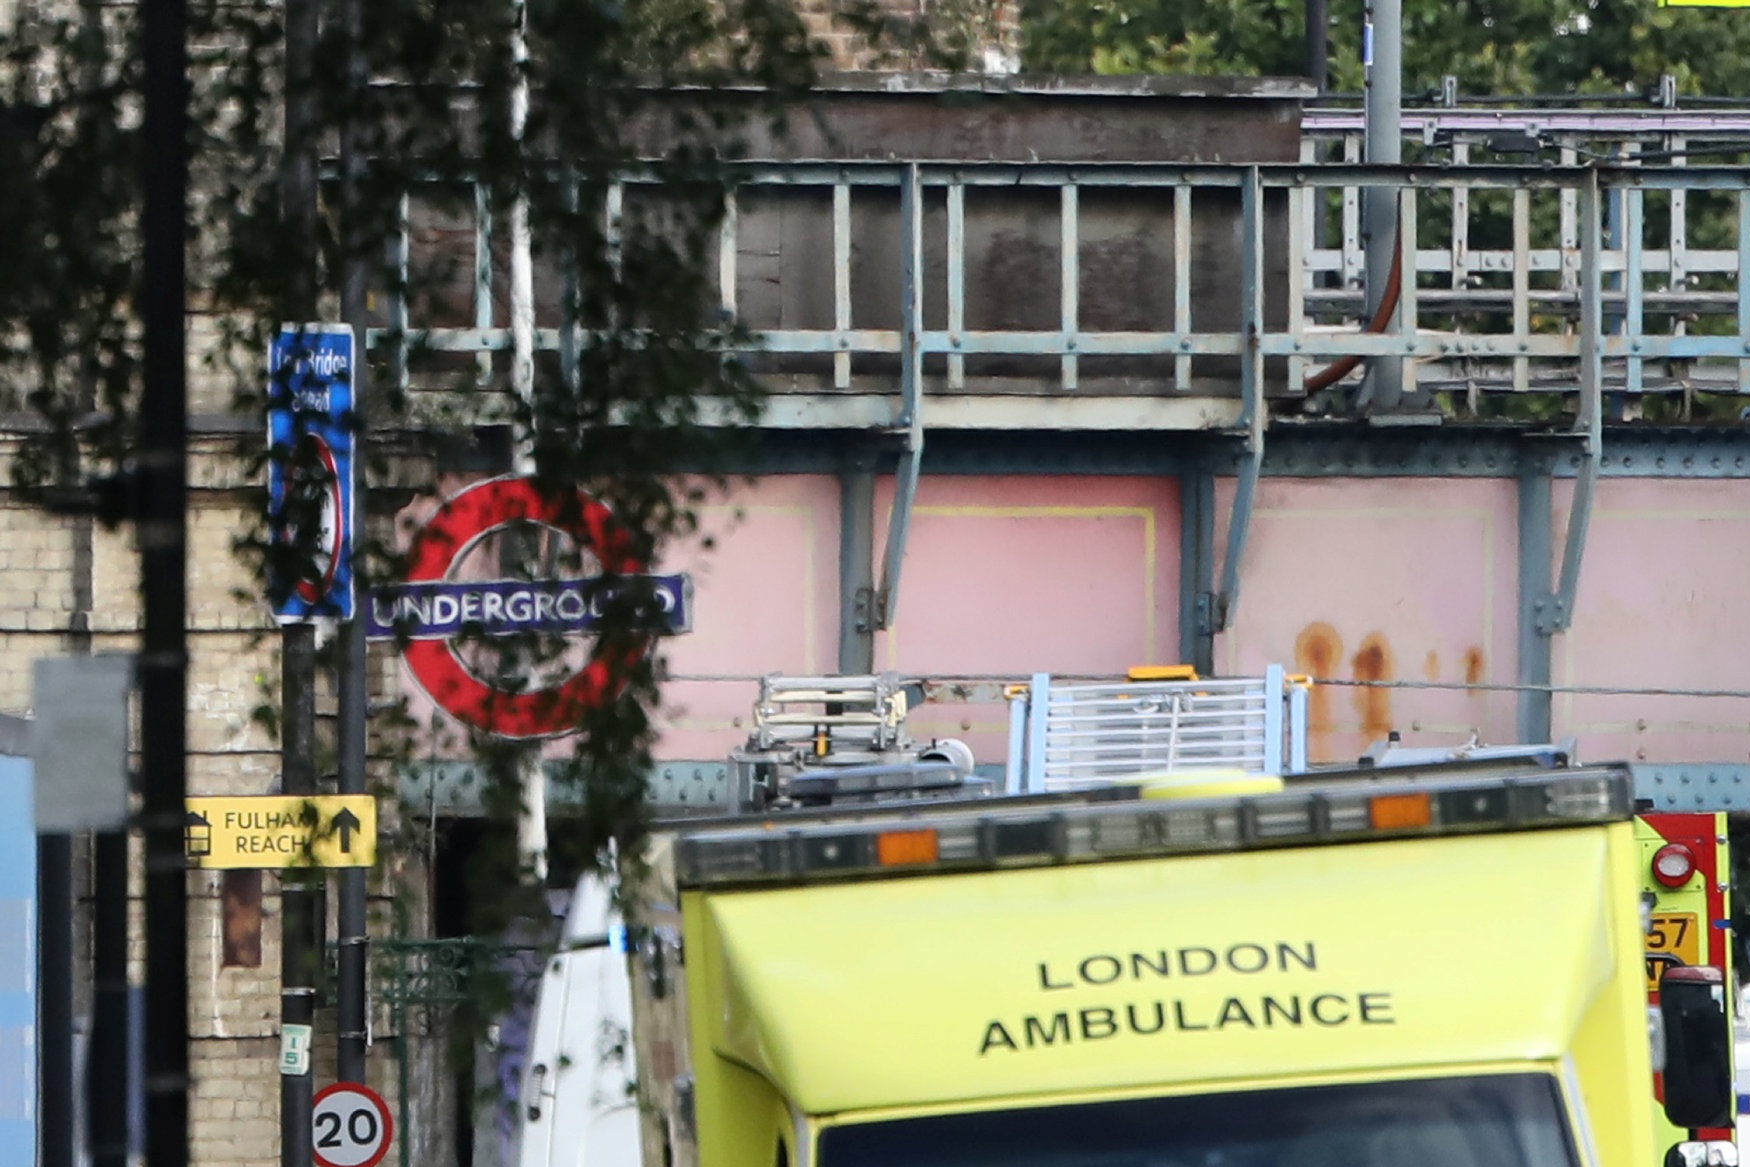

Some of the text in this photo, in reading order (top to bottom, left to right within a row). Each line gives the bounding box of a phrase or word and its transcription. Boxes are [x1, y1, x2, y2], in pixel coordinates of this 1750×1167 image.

[1037, 941, 1318, 991] LONDON
[977, 992, 1397, 1057] AMBULANCE
[314, 1108, 378, 1149] 20
